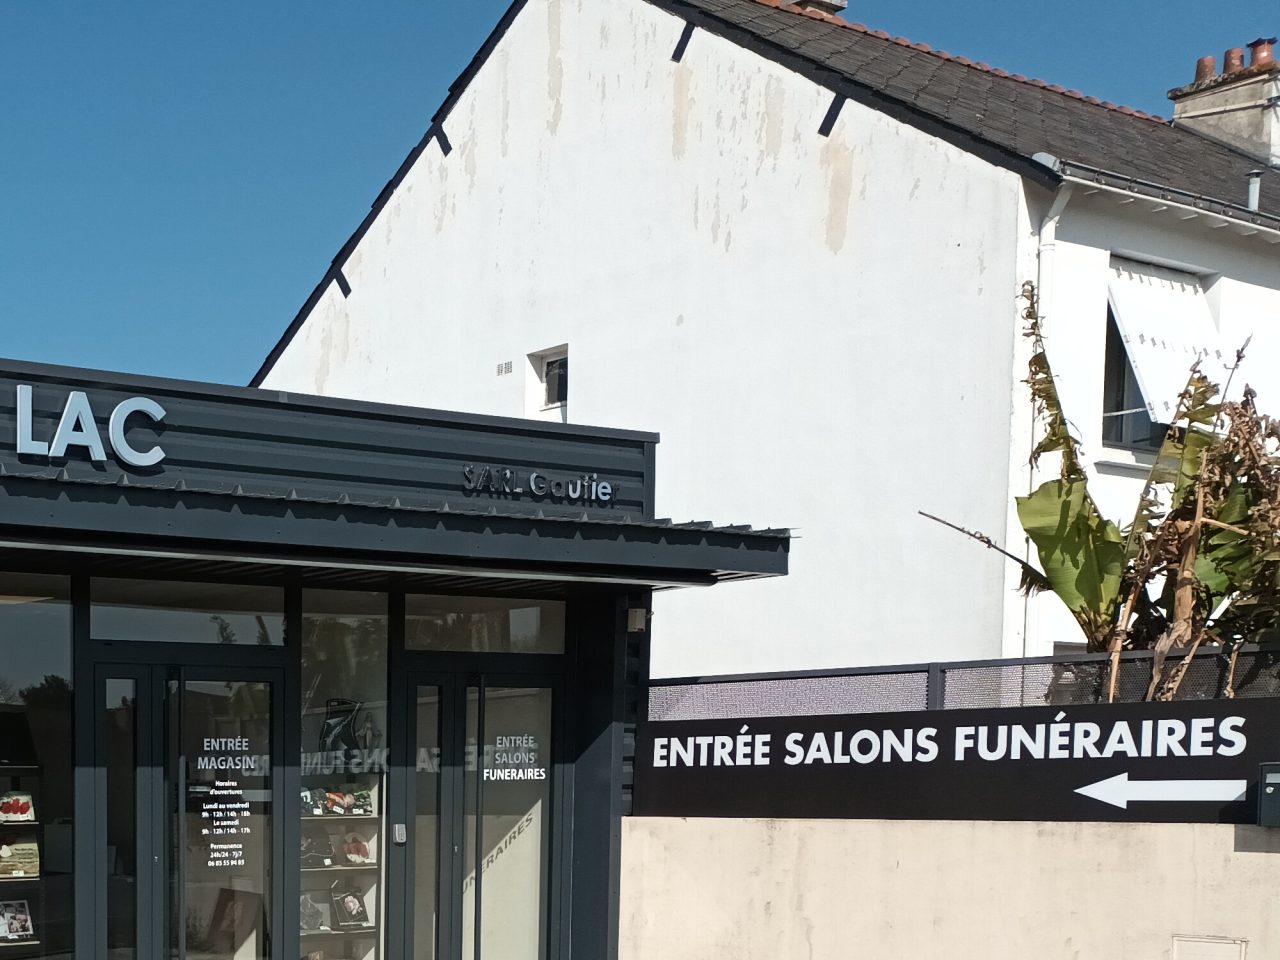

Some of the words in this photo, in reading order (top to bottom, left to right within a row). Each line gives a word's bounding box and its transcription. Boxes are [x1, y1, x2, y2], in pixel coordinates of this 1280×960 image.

[17, 384, 167, 467] LAC
[463, 465, 523, 492] SARL
[204, 736, 249, 751] ENTRÉE
[496, 734, 534, 748] ENTRÉE
[653, 725, 771, 768] ENTRÉE
[785, 727, 939, 766] SALONS
[954, 711, 1248, 761] FUNÉRAIRES
[198, 756, 255, 769] MAGASIN
[495, 752, 535, 765] SALONS
[483, 767, 546, 781] FUNERAIRES
